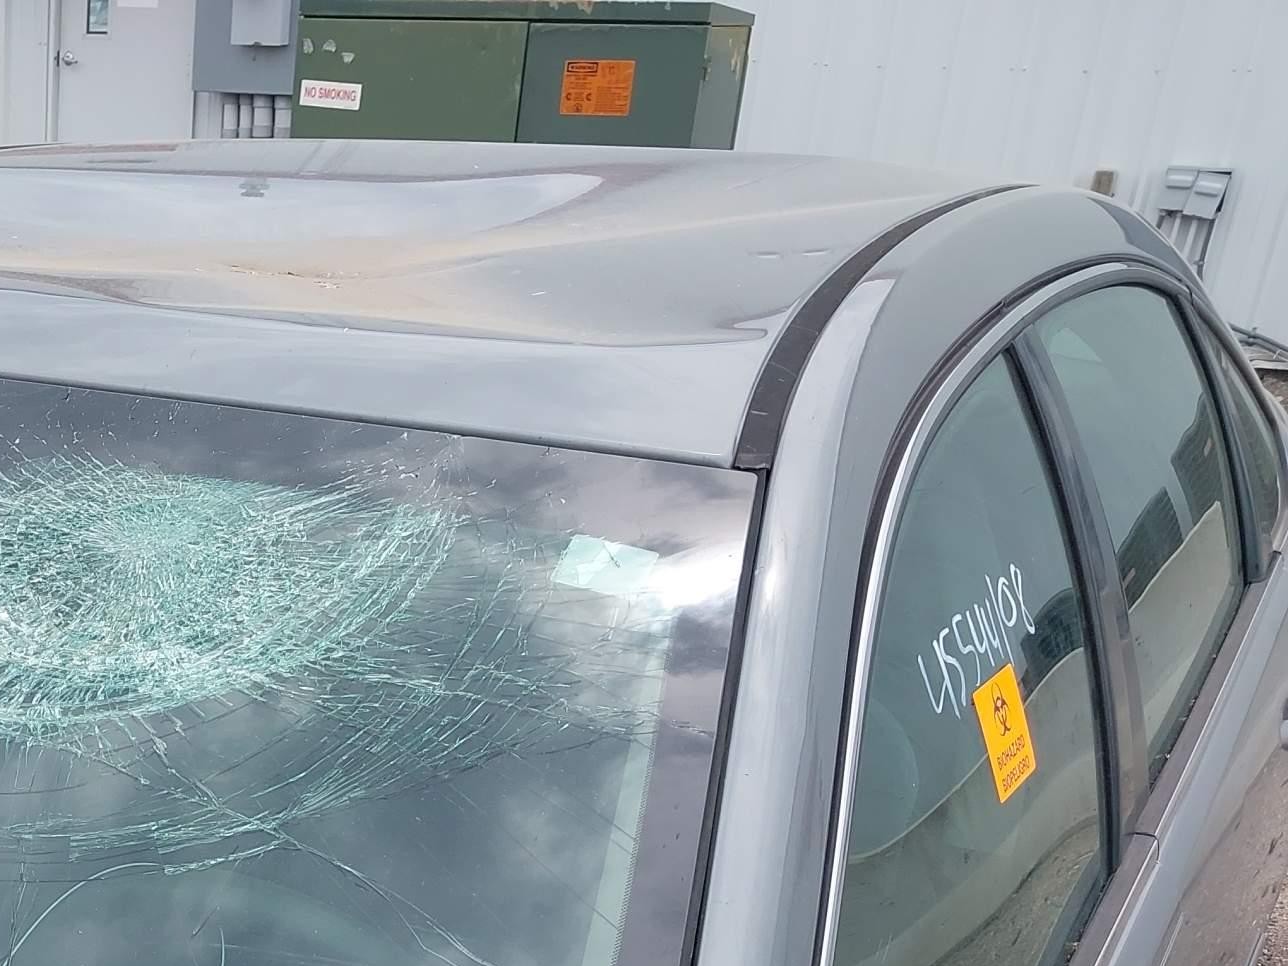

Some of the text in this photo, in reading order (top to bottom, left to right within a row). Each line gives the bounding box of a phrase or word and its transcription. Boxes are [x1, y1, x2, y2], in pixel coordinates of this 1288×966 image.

[304, 86, 356, 102] NO SMOKING
[917, 563, 1036, 720] 45544108
[996, 734, 1025, 772] BIOHAZARD
[1002, 755, 1030, 793] BIOPELIGRO
